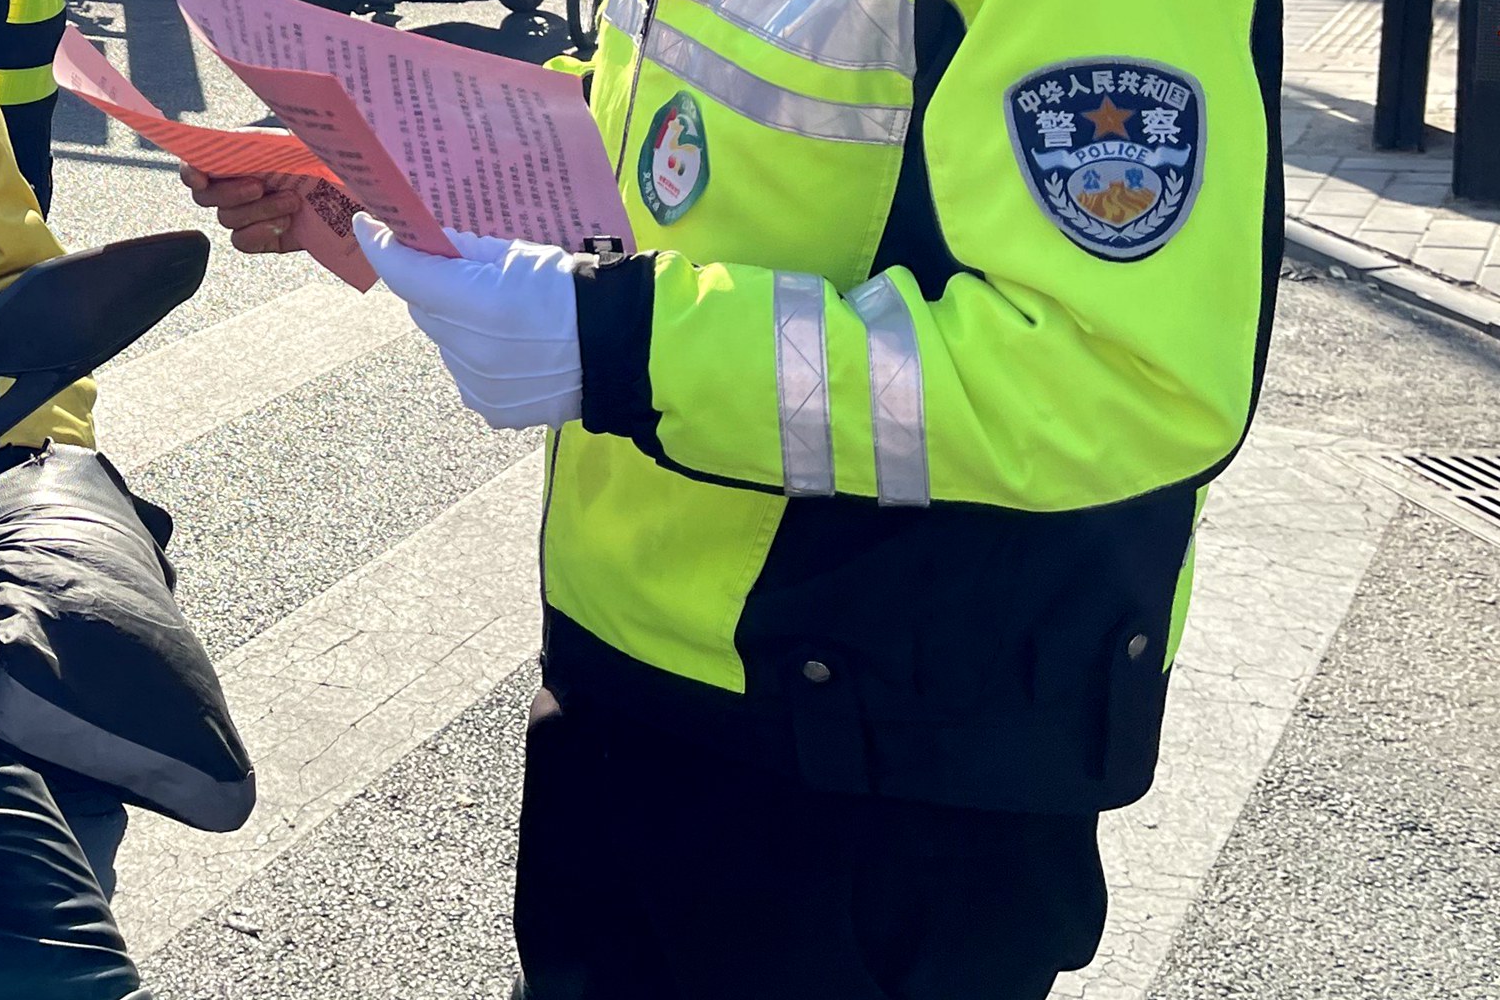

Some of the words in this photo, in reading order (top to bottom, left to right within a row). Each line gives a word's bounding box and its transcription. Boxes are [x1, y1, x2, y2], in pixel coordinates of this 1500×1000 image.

[1017, 70, 1192, 114] 中华人民共和国
[1036, 110, 1077, 148] 警
[1141, 107, 1181, 144] 察
[1075, 143, 1149, 163] POLICE
